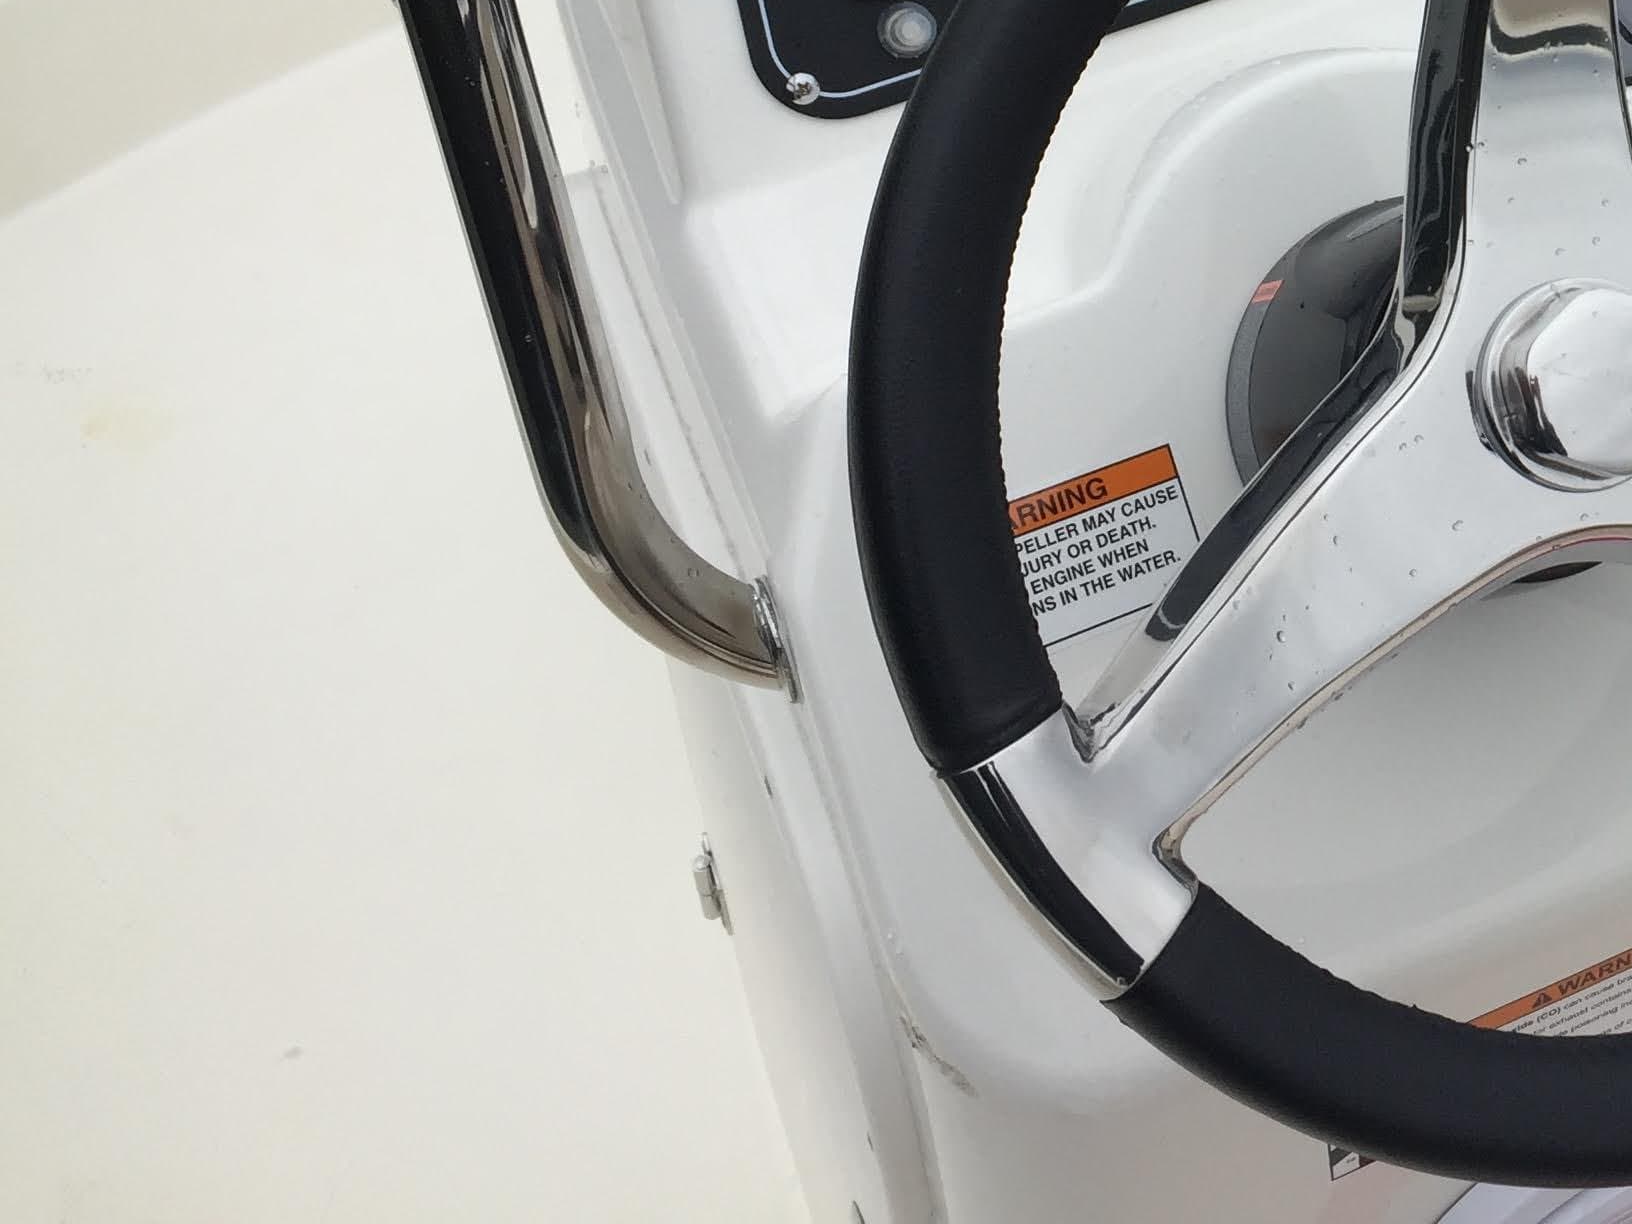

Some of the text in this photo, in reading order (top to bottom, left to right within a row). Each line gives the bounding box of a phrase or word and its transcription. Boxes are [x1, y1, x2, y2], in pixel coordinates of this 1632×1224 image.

[1014, 478, 1108, 529] RNING
[1082, 507, 1115, 532] MAY
[1121, 485, 1179, 517] CAUSE
[1067, 539, 1093, 559] OR
[1096, 516, 1157, 548] DEATH.
[1030, 539, 1149, 595] ENGINE WHEN
[1060, 587, 1078, 606] IN
[1080, 573, 1116, 597] THE
[1118, 550, 1182, 582] WATER.
[1537, 1006, 1561, 1023] (CO)
[1563, 997, 1583, 1010] can
[1585, 983, 1614, 1001] cause
[1591, 988, 1632, 1010] contains
